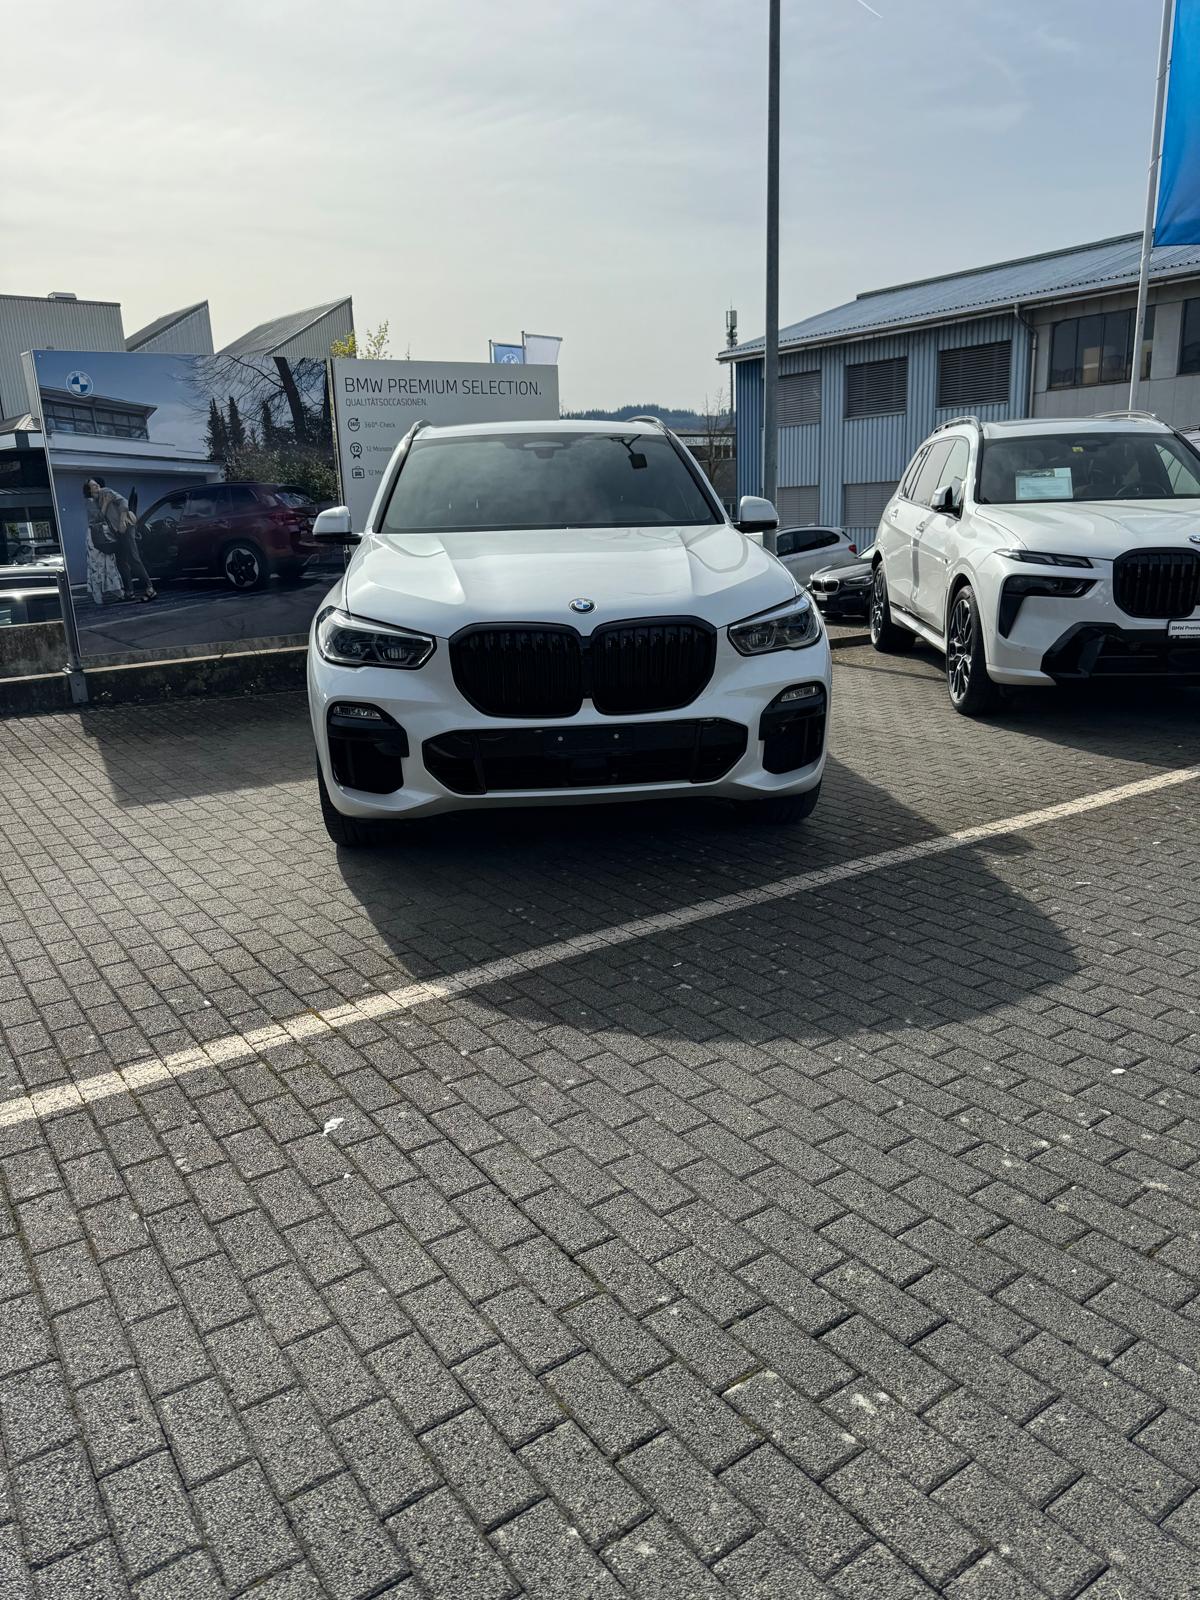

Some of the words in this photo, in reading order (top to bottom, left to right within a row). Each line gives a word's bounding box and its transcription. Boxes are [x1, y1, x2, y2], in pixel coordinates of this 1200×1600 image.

[345, 377, 383, 393] BMW
[387, 378, 458, 395] PREMIUM
[462, 380, 542, 396] SELECTION.
[352, 445, 360, 453] 12
